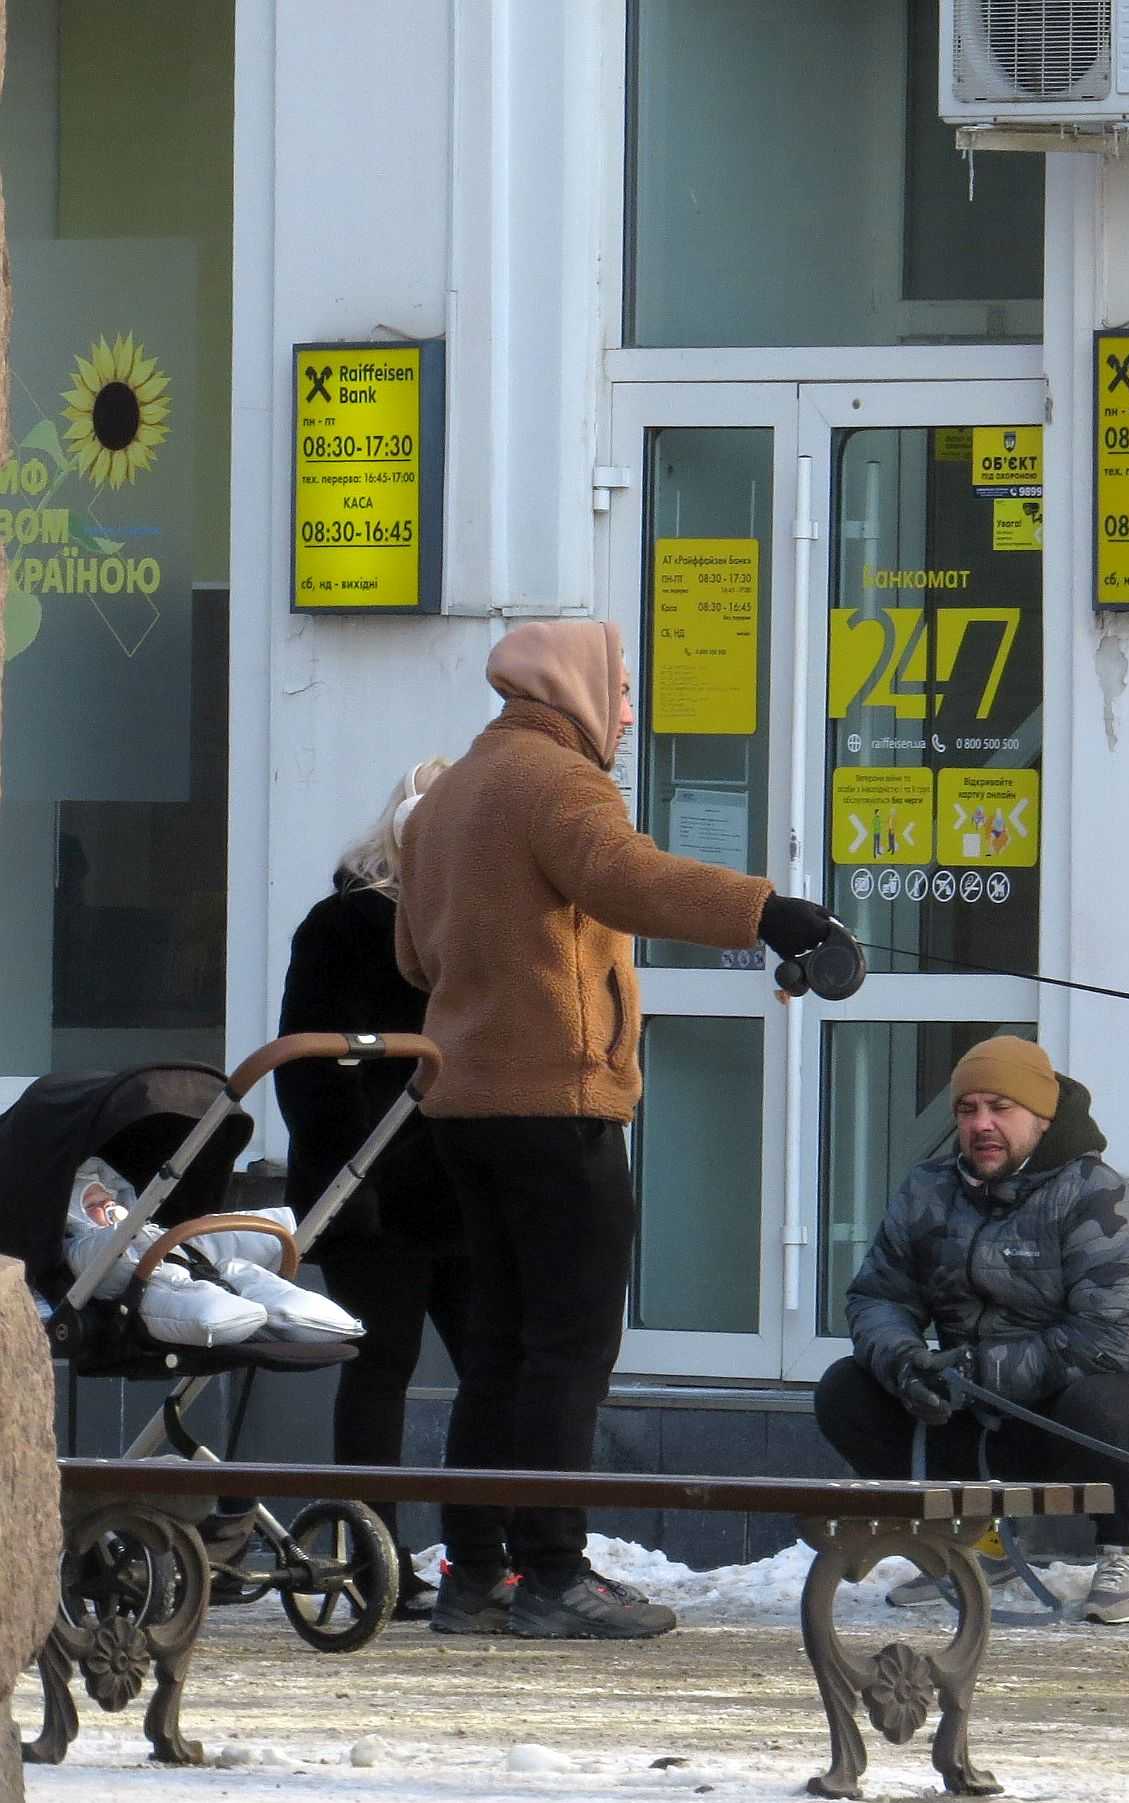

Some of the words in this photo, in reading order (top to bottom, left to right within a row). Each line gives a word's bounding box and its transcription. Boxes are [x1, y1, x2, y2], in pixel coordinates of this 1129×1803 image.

[340, 364, 414, 382] Raiffeisen
[340, 386, 377, 404] Bank
[1104, 407, 1118, 417] пн
[303, 417, 315, 427] пн
[325, 417, 336, 427] пт
[303, 435, 413, 458] 08:30-17:30
[981, 456, 1038, 471] ОБ'ЄКТ
[995, 472, 1038, 480] ОХОРОНОЮ
[1104, 466, 1122, 477] тех.
[302, 473, 319, 484] тех.
[321, 473, 362, 486] перерва:
[364, 472, 416, 484] 16:45-17:00
[343, 496, 374, 510] КАСА
[302, 520, 413, 544] 08:30-16:45
[862, 564, 971, 589] Банкомат
[1104, 573, 1120, 587] сб,
[301, 577, 315, 591] сб,
[319, 579, 332, 591] нд
[341, 577, 379, 590] вихідні
[871, 737, 927, 750] raiffeisen.ua
[956, 738, 962, 750] 0
[964, 738, 981, 750] 800
[983, 738, 1000, 750] 500
[1001, 738, 1020, 750] 500
